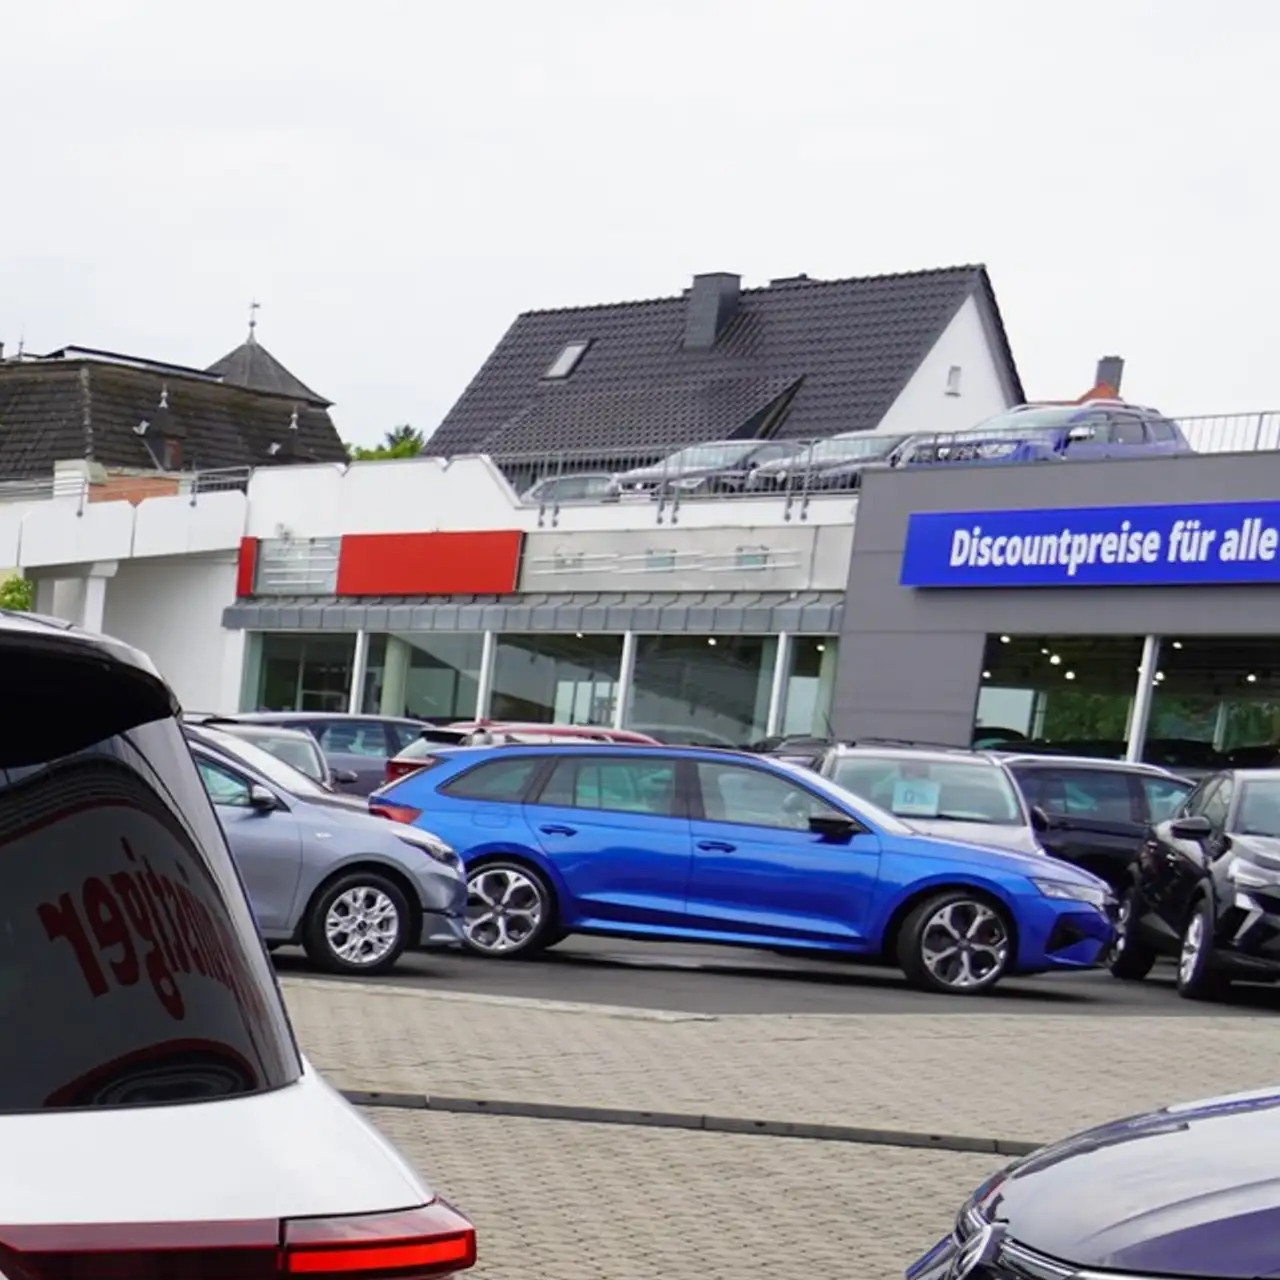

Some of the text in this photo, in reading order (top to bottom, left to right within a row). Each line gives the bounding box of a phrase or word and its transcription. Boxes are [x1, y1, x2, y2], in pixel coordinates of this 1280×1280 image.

[950, 518, 1278, 576] Discountpreise für alle
